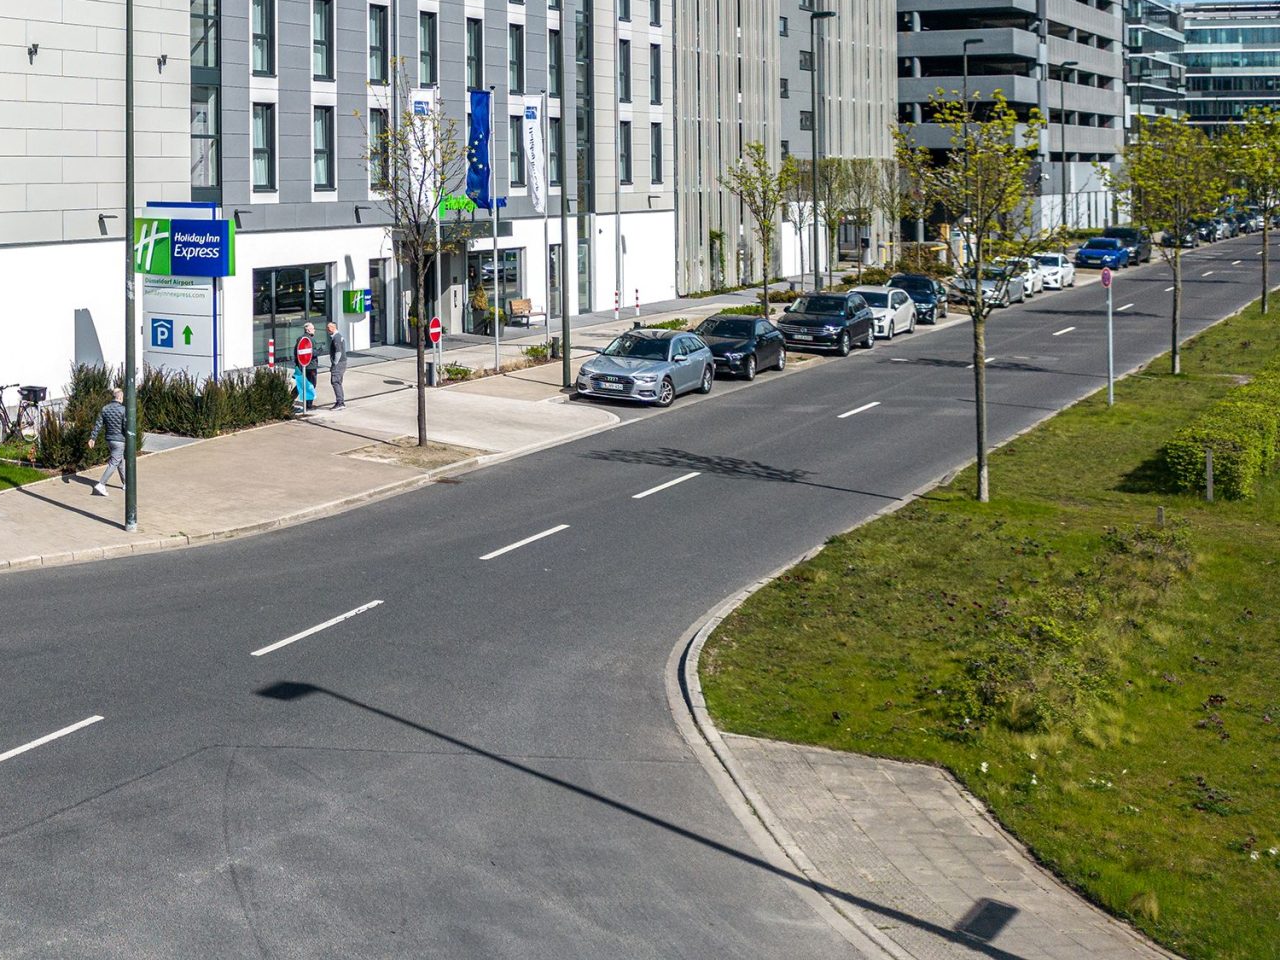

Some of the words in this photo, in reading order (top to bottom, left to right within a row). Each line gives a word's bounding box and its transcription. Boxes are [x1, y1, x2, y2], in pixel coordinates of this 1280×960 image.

[174, 232, 206, 245] Holiday
[206, 233, 220, 243] Inn
[174, 244, 220, 260] Express
[157, 327, 169, 345] P
